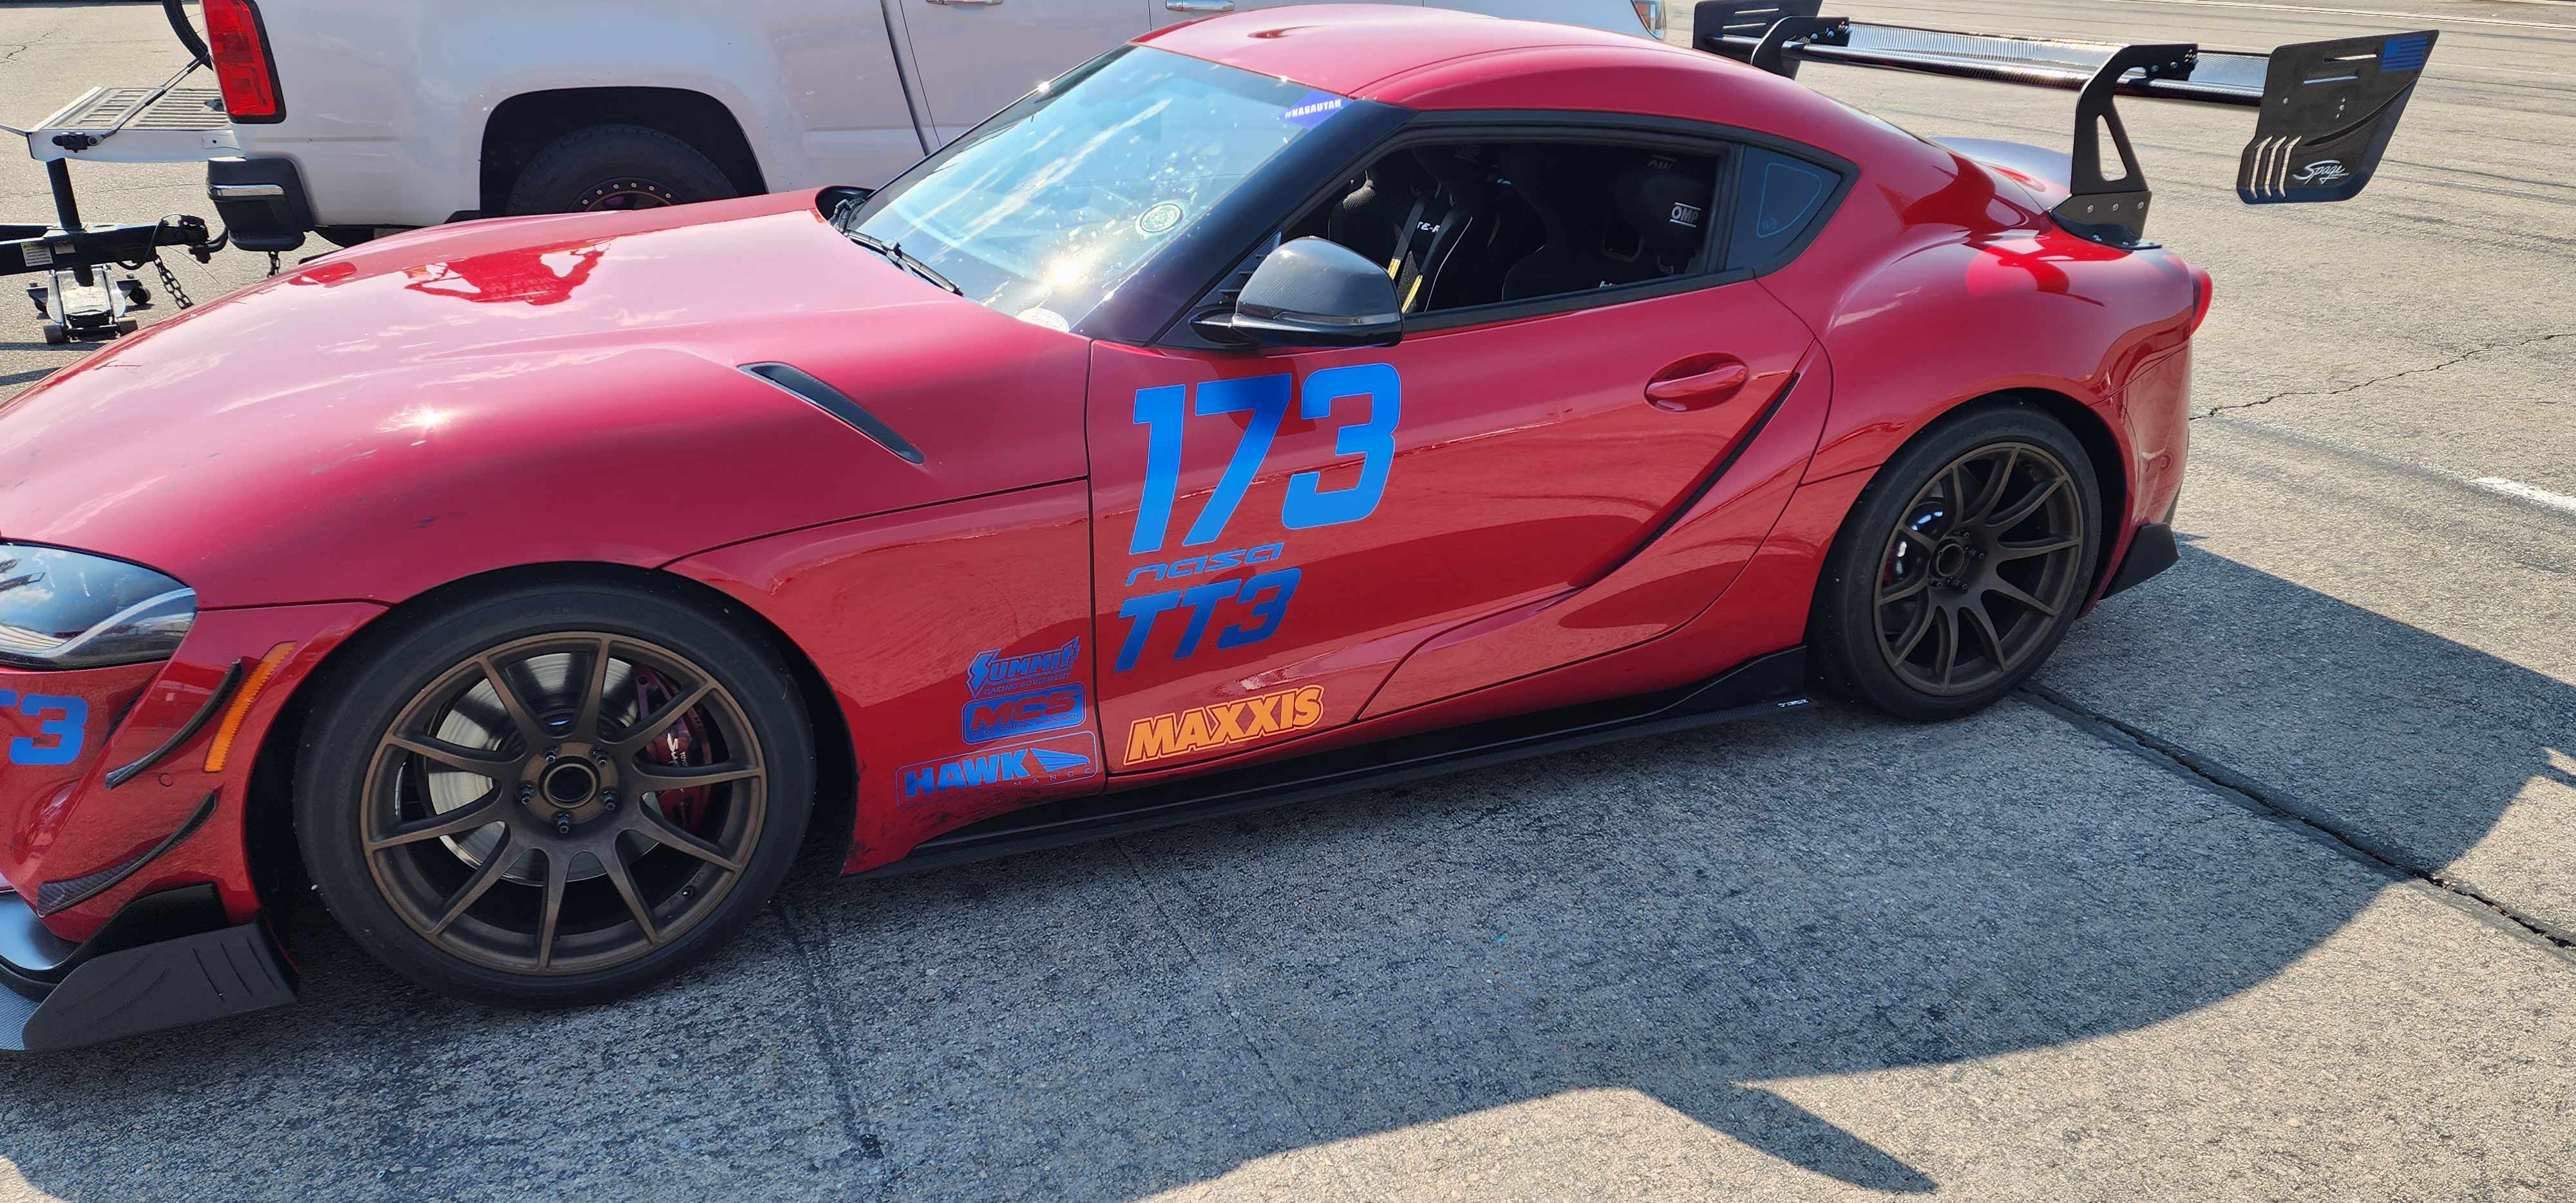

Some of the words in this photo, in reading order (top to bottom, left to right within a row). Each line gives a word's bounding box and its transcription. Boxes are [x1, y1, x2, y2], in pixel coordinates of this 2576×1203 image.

[1672, 205, 1699, 223] OMP
[1129, 363, 1401, 555] 173
[1113, 567, 1302, 673] TT3
[0, 688, 88, 765] 3
[970, 690, 1078, 731] MCS
[1126, 687, 1322, 764] MAXXIS
[905, 749, 1030, 797] HAWK
